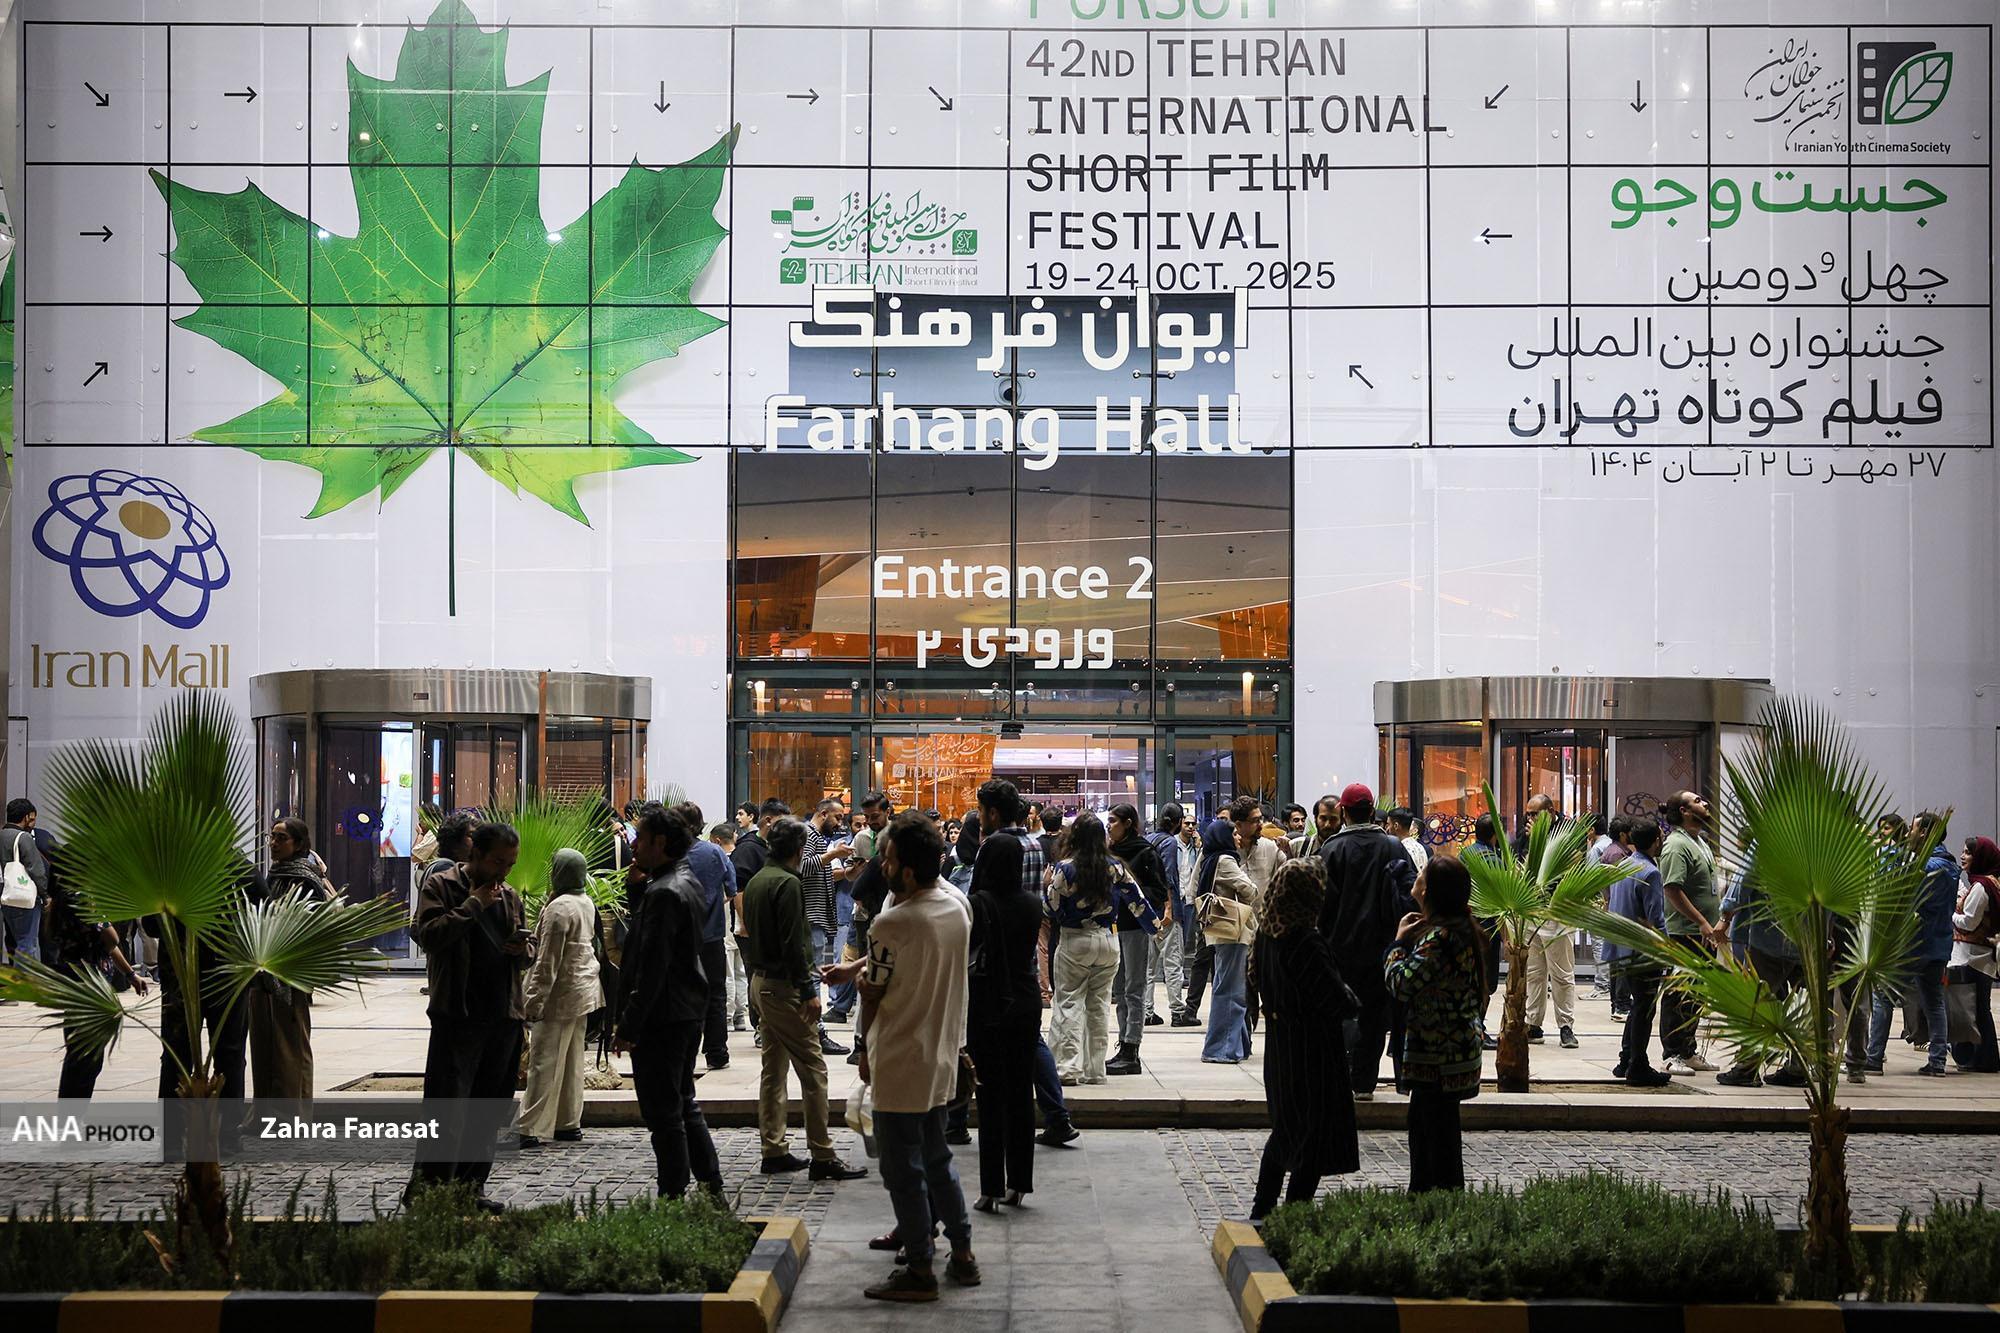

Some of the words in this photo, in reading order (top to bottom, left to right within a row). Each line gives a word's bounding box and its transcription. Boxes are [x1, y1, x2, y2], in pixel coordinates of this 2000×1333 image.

[1025, 39, 1135, 77] 42ND
[1157, 38, 1346, 76] TEHRAN
[1027, 95, 1448, 135] INTERNATIONAL
[1794, 142, 1833, 153] Iranian
[1834, 142, 1867, 153] Youth
[1868, 142, 1909, 153] Cinema
[1910, 142, 1951, 154] Society
[1026, 153, 1183, 192] SHORT
[1207, 153, 1329, 191] FILM
[1028, 212, 1279, 249] FESTIVAL
[809, 263, 902, 285] TEHRAN
[904, 265, 977, 276] International
[1156, 262, 1228, 290] OCT.
[1247, 261, 1336, 290] 2025
[1841, 251, 1949, 304] چهل
[789, 284, 1058, 373] فرهنگ
[1082, 286, 1249, 372] ایوان
[1749, 317, 1945, 369] جشنواره
[1508, 379, 1659, 438] تهران
[1677, 379, 1807, 437] کوتاه
[1823, 376, 1943, 439] فیلم
[765, 391, 1060, 471] Farhang
[1096, 393, 1252, 454] Hall
[1591, 451, 1652, 477] ۱۴۰۴
[1662, 450, 1750, 484] آبان
[1786, 454, 1813, 477] تا
[1822, 460, 1898, 483] مهر
[873, 555, 1109, 599] Entrance
[1127, 556, 1154, 599] 2
[31, 644, 131, 688] Iran
[142, 644, 229, 689] Mall
[917, 628, 942, 669] ۲
[962, 627, 1114, 669] ورودی
